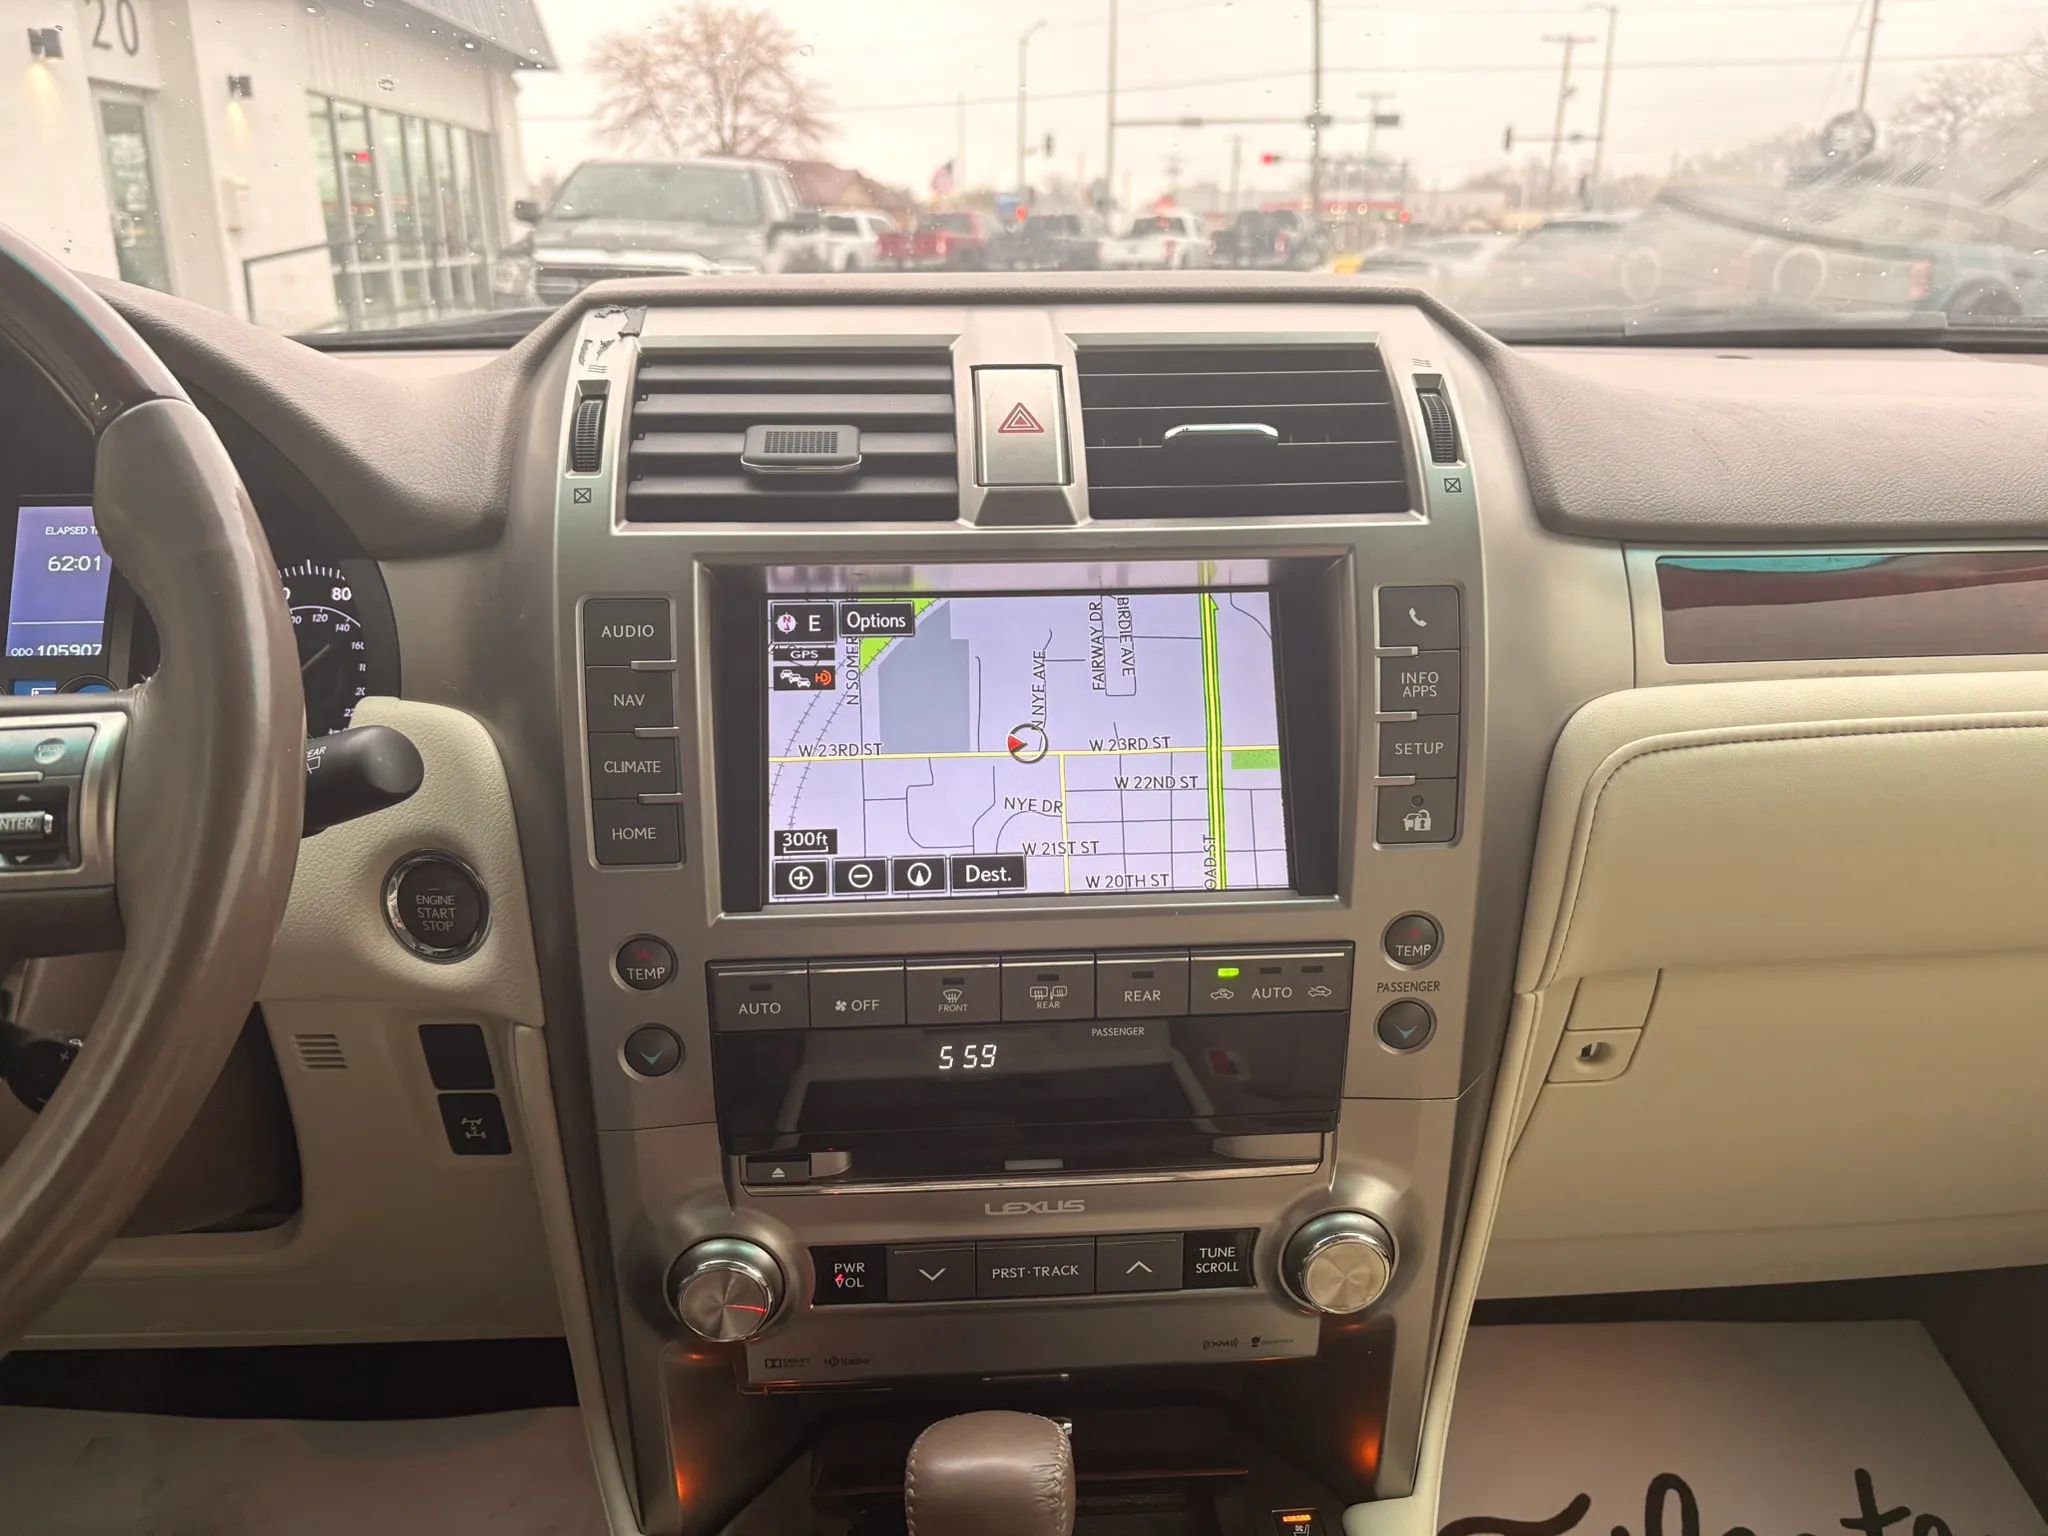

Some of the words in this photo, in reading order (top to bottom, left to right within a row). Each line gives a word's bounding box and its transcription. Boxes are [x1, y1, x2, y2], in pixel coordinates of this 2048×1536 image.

[45, 526, 88, 536] ELAPSED
[47, 555, 101, 572] 62:01
[331, 587, 352, 601] 80
[312, 613, 328, 623] 120
[1088, 601, 1103, 622] DR
[808, 614, 821, 632] E
[846, 610, 906, 629] Options
[1117, 597, 1134, 643] BIRDIE
[335, 622, 350, 633] 140
[601, 624, 655, 638] AUDIO
[11, 647, 34, 657] ODO
[37, 644, 103, 656] 105907
[790, 649, 819, 659] GPS
[1033, 650, 1046, 680] AVE
[1089, 625, 1106, 691] FAIRWAY
[1120, 646, 1136, 677] AVE
[1401, 671, 1439, 685] INFO
[1402, 686, 1438, 698] APPS
[613, 693, 645, 706] NAV
[1032, 684, 1045, 716] NYE
[799, 745, 813, 757] W
[819, 744, 858, 757] 23RD
[863, 743, 883, 756] ST
[1089, 738, 1104, 752] W
[1108, 738, 1148, 751] 23RD
[1153, 736, 1171, 749] ST
[1395, 742, 1444, 755] SETUP
[603, 760, 662, 774] CLIMATE
[1114, 777, 1129, 789] W
[1134, 776, 1175, 789] 22ND
[1181, 775, 1198, 788] ST
[1004, 796, 1037, 811] NYE
[1043, 799, 1063, 813] DR
[612, 828, 657, 841] HOME
[782, 831, 829, 847] 300ft
[1022, 842, 1037, 855] W
[1043, 842, 1076, 855] 21ST
[1081, 841, 1100, 854] ST
[965, 864, 1012, 883] Dest.
[1086, 875, 1101, 888] W
[1105, 875, 1146, 888] 20TH
[1151, 874, 1170, 887] ST
[416, 895, 455, 906] ENGINE
[417, 907, 456, 919] START
[423, 920, 454, 932] STOP
[1395, 943, 1432, 958] TEMP
[627, 966, 666, 981] TEMP
[1251, 986, 1293, 1000] AUTO
[1376, 981, 1441, 994] PASSENGER
[1123, 990, 1161, 1003] REAR
[738, 1002, 782, 1015] AUTO
[851, 999, 880, 1012] OFF
[938, 1004, 969, 1013] FRONT
[1036, 1000, 1060, 1009] REAR
[1091, 1026, 1145, 1038] PASSENGER
[985, 1199, 1086, 1216] LEXUS
[1199, 1247, 1236, 1259] TUNE
[834, 1262, 865, 1274] PWR
[1195, 1260, 1240, 1274] SCROLL
[835, 1276, 865, 1288] VOL
